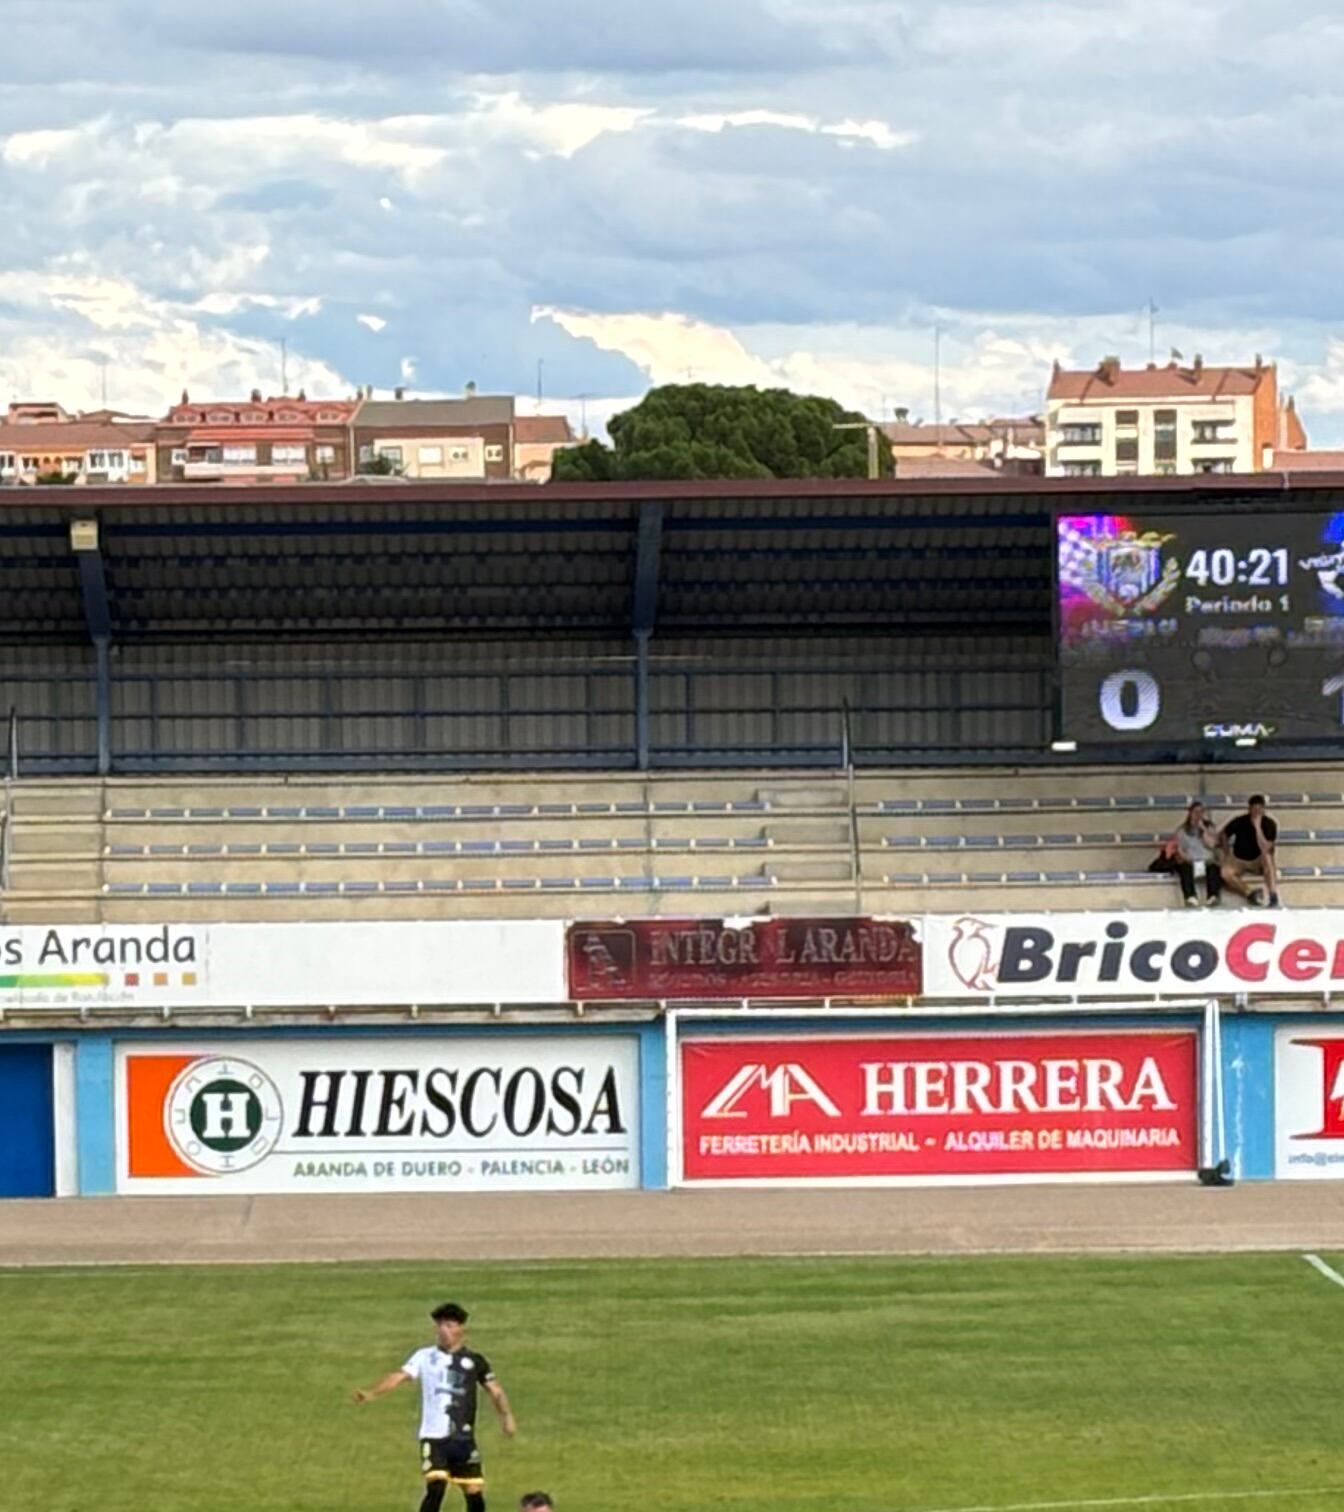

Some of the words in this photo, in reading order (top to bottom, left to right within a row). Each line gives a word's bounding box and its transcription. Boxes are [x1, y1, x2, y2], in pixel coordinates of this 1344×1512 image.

[1186, 548, 1289, 587] 40:21
[1185, 595, 1273, 614] Periodo
[1099, 669, 1161, 731] 0
[38, 923, 197, 966] Aranda
[650, 928, 795, 966] INTEGRL
[291, 1066, 627, 1139] HIESCOSA
[860, 1057, 1178, 1117] HERRERA
[700, 1129, 812, 1155] FERRETERÍA
[814, 1132, 919, 1152] INDUSTRIAL
[944, 1130, 1034, 1152] ALQUILER
[1038, 1130, 1063, 1150] DE
[1067, 1128, 1181, 1149] MAQUINARIA
[294, 1161, 368, 1177] ARANDA
[374, 1161, 396, 1176] DE
[402, 1160, 461, 1177] DUERO
[481, 1158, 565, 1175] PALENCIA
[583, 1153, 630, 1175] LEÓN
